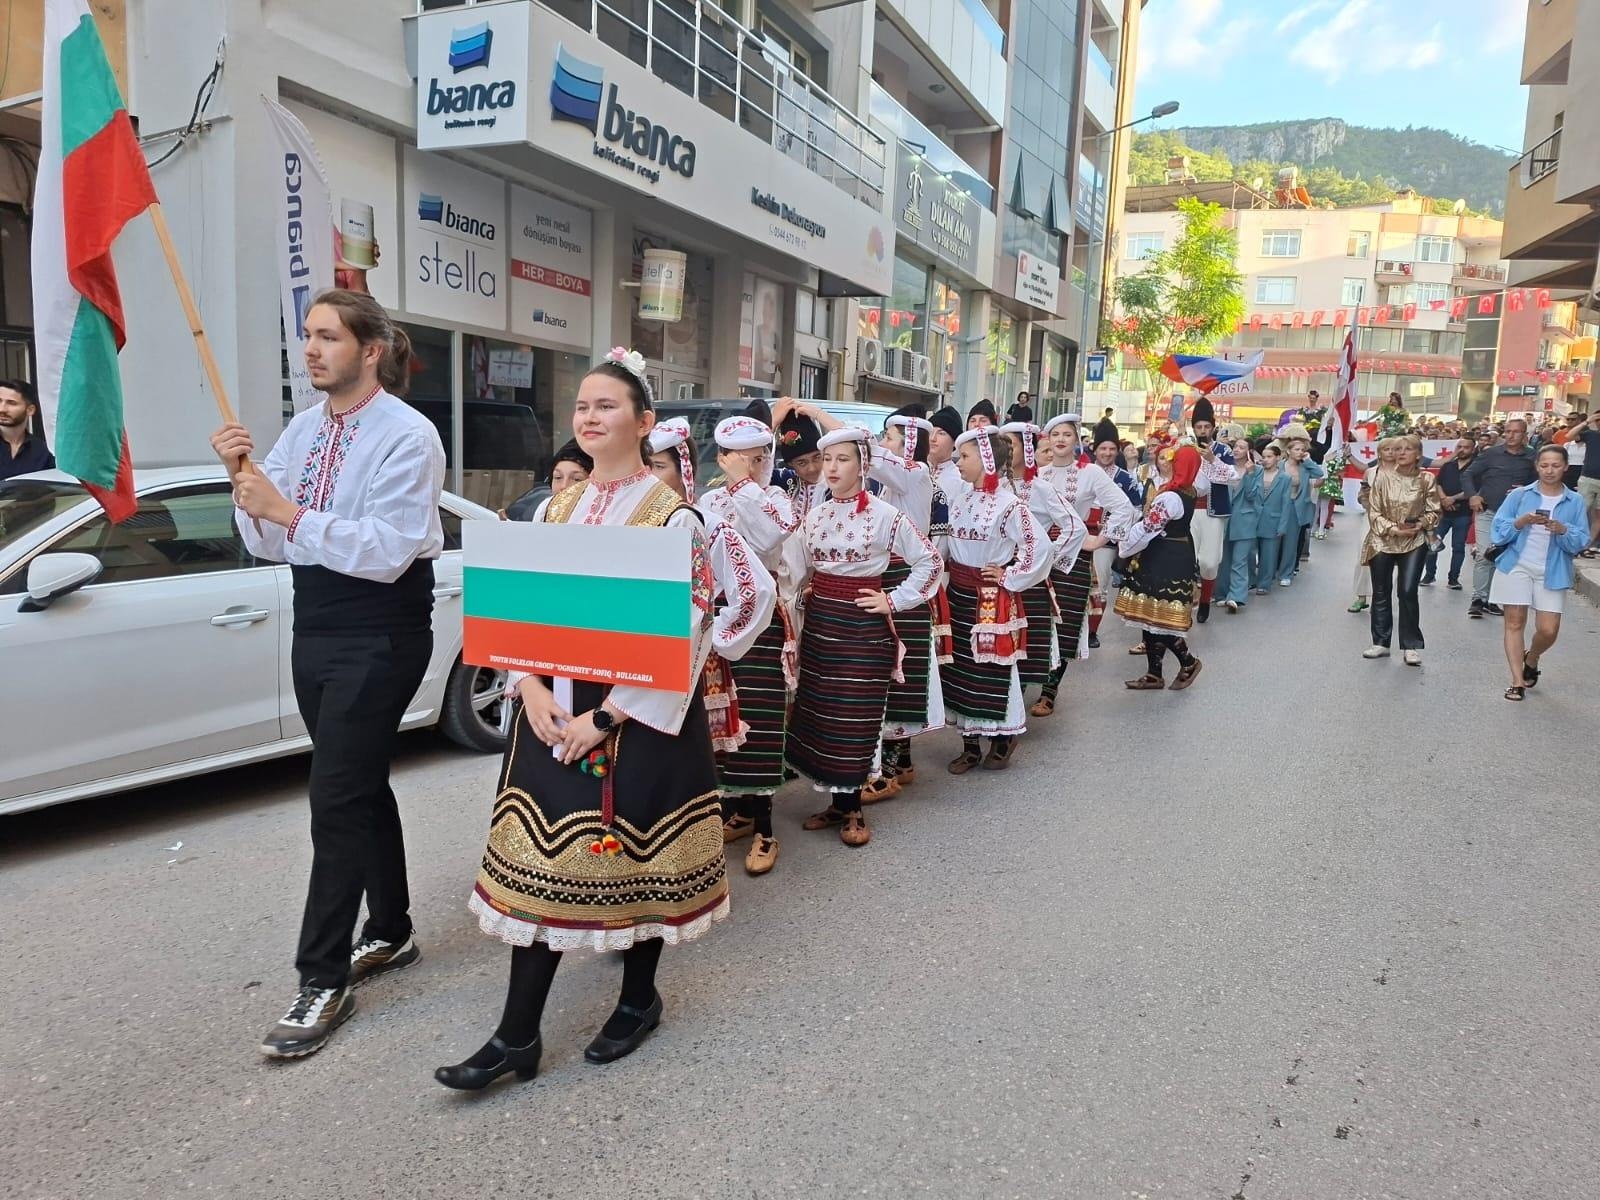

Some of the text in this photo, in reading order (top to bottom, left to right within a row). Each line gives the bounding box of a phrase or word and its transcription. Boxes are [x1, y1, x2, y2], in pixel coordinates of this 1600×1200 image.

[427, 78, 515, 115] bianca
[603, 83, 696, 177] bianca
[636, 164, 660, 184] rengi
[446, 203, 495, 240] bianca
[536, 214, 571, 233] yeni nesil
[751, 187, 826, 238] Keskin Dekorasyon
[523, 225, 558, 246] dönüşüm
[954, 219, 972, 246] AKIN
[418, 241, 496, 298] stella
[522, 263, 545, 281] HER
[555, 272, 585, 292] BOYA
[543, 312, 568, 329] bianca
[489, 655, 509, 664] YOUTH
[509, 657, 534, 667] FOLKLOR
[534, 661, 555, 670] GROUP
